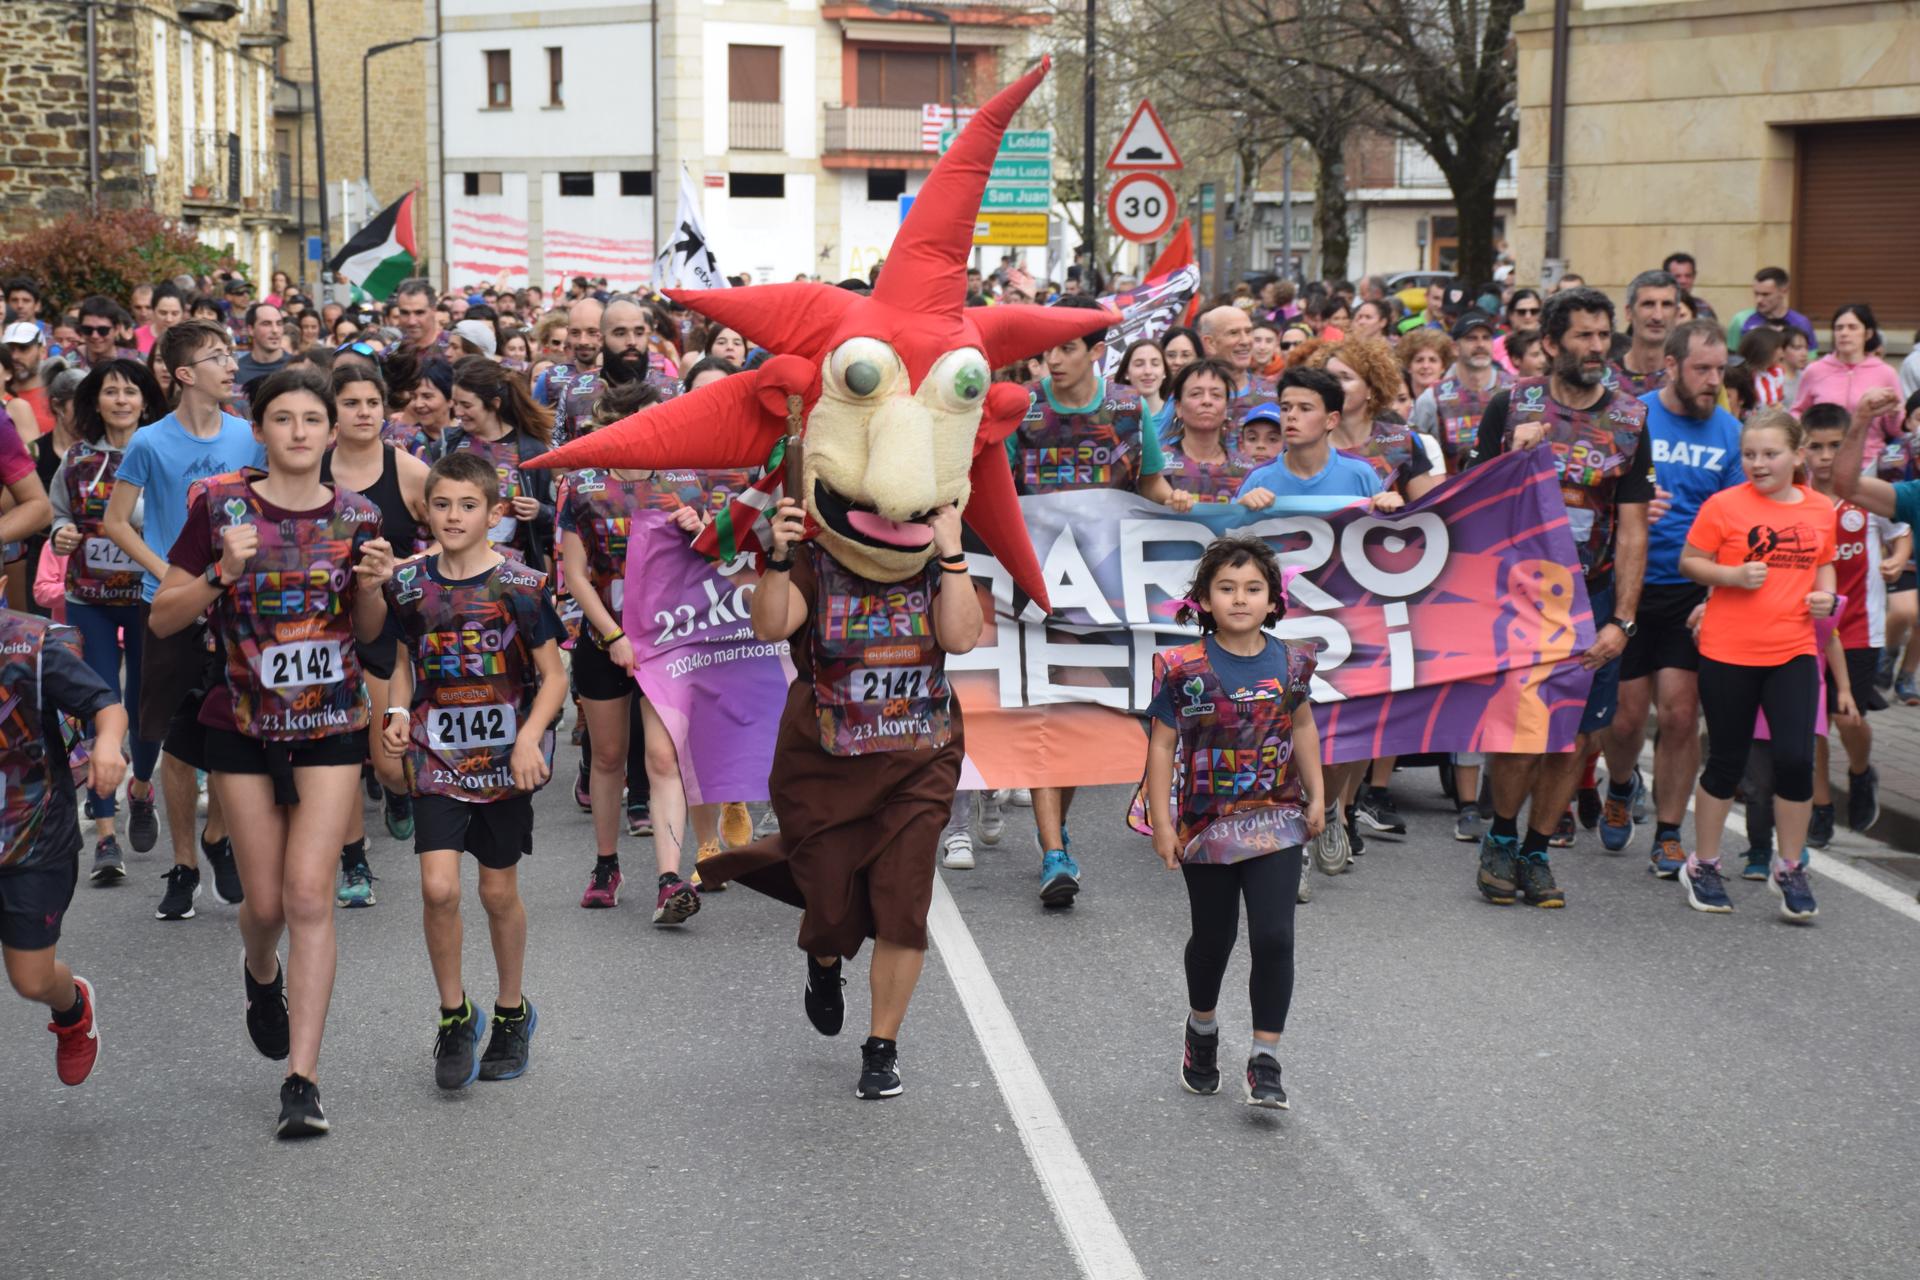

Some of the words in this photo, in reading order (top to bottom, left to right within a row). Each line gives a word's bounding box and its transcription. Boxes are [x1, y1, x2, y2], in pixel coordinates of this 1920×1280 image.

[992, 166, 1017, 177] anta
[988, 189, 1014, 203] San
[1016, 189, 1048, 203] Juan
[1124, 196, 1162, 218] 30
[1024, 447, 1111, 465] HARRO
[1652, 439, 1727, 471] BATZ
[1024, 465, 1111, 484] HERRI
[81, 584, 141, 600] 23.korri
[512, 575, 538, 588] eitb
[827, 591, 927, 617] HARRO
[825, 613, 932, 641] HERRI
[4, 643, 32, 655] eitb
[868, 648, 917, 661] euskaltel
[272, 646, 333, 685] 2142
[666, 653, 712, 679] 2024ko
[441, 688, 489, 701] euskaltel
[863, 669, 923, 701] 2142
[262, 703, 348, 731] 23.korrika
[438, 708, 506, 744] 2142
[853, 713, 932, 742] 23.korrika
[1191, 741, 1290, 772] HARRO
[432, 766, 516, 790] 23.korrik
